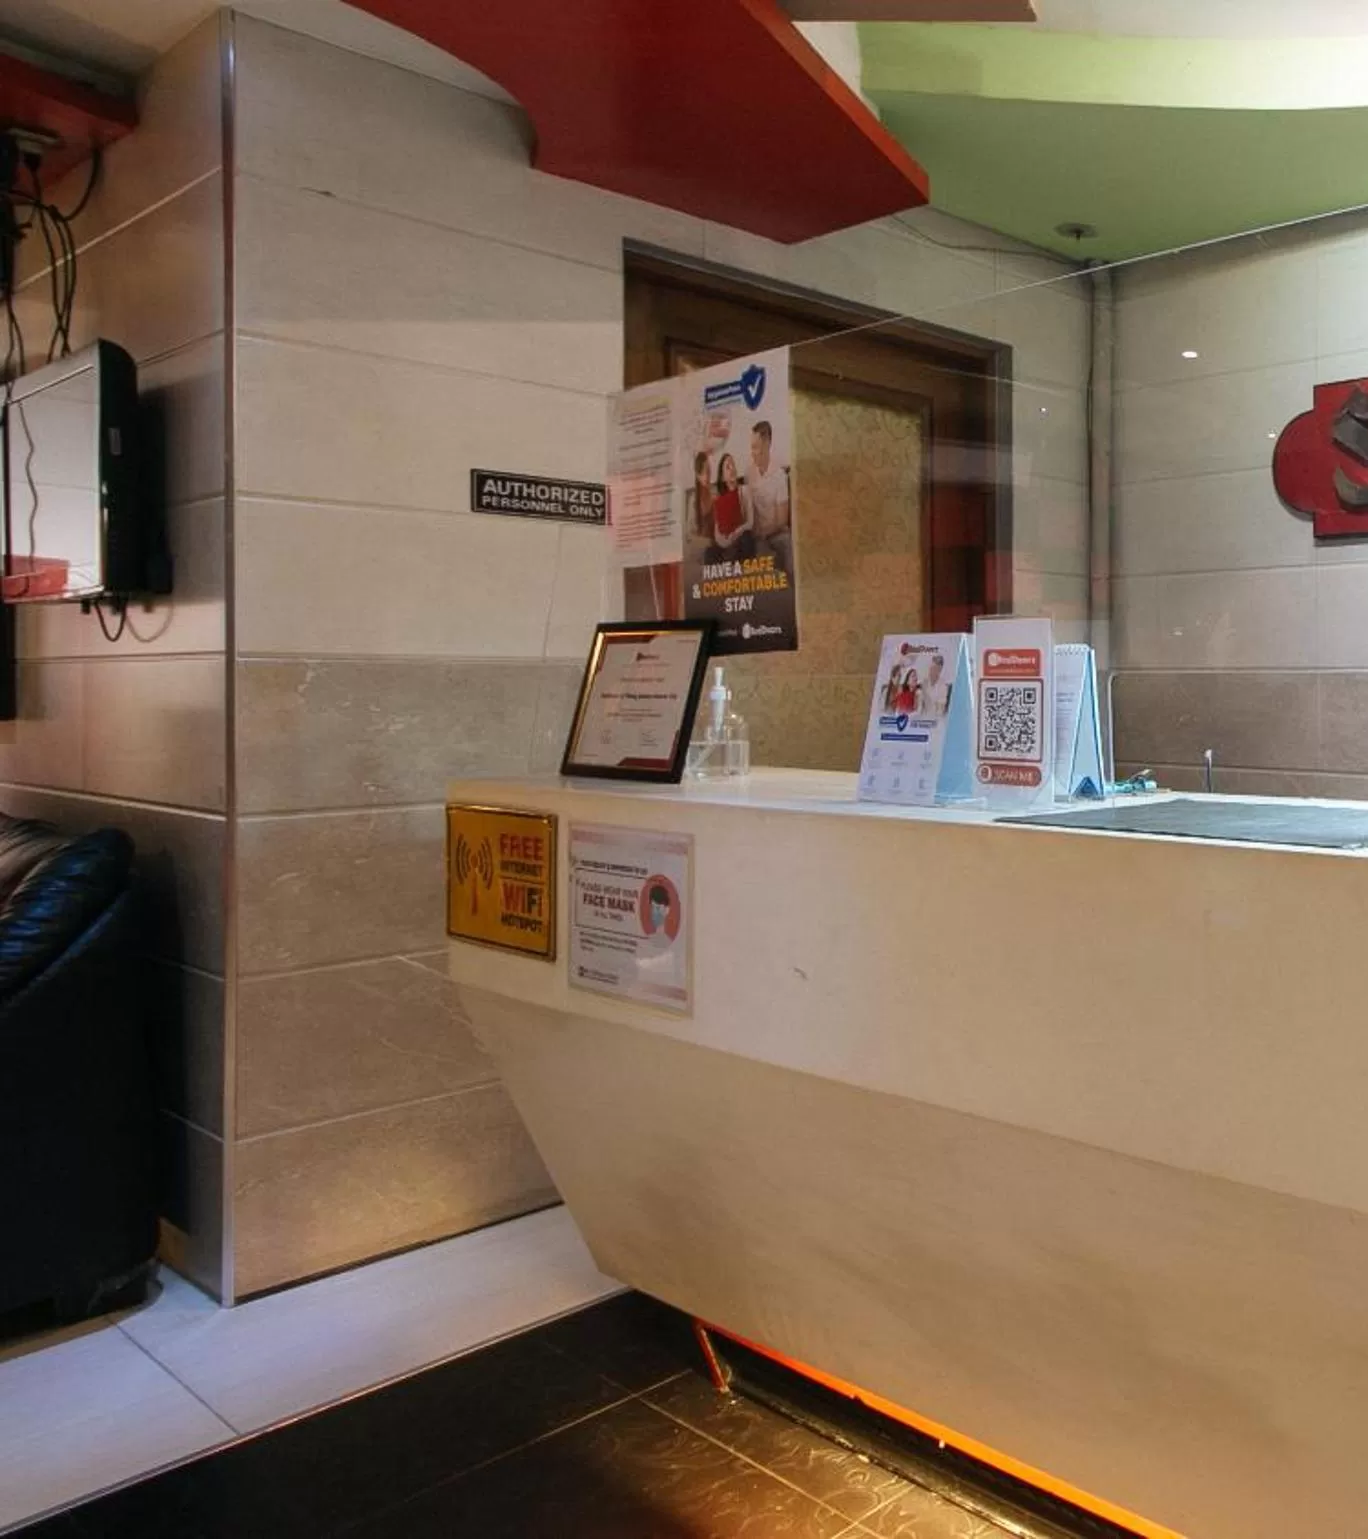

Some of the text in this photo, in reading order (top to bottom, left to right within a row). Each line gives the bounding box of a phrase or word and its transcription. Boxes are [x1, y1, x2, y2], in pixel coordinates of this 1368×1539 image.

[483, 479, 604, 505] AUTHORIZED
[482, 495, 604, 517] PERSONNEL ONLY
[703, 556, 774, 579] HAVE A SAFE
[692, 571, 787, 599] & COMFORTABLE
[725, 595, 754, 612] STAY
[500, 833, 544, 861] FREE
[583, 892, 636, 914] FACE MASK
